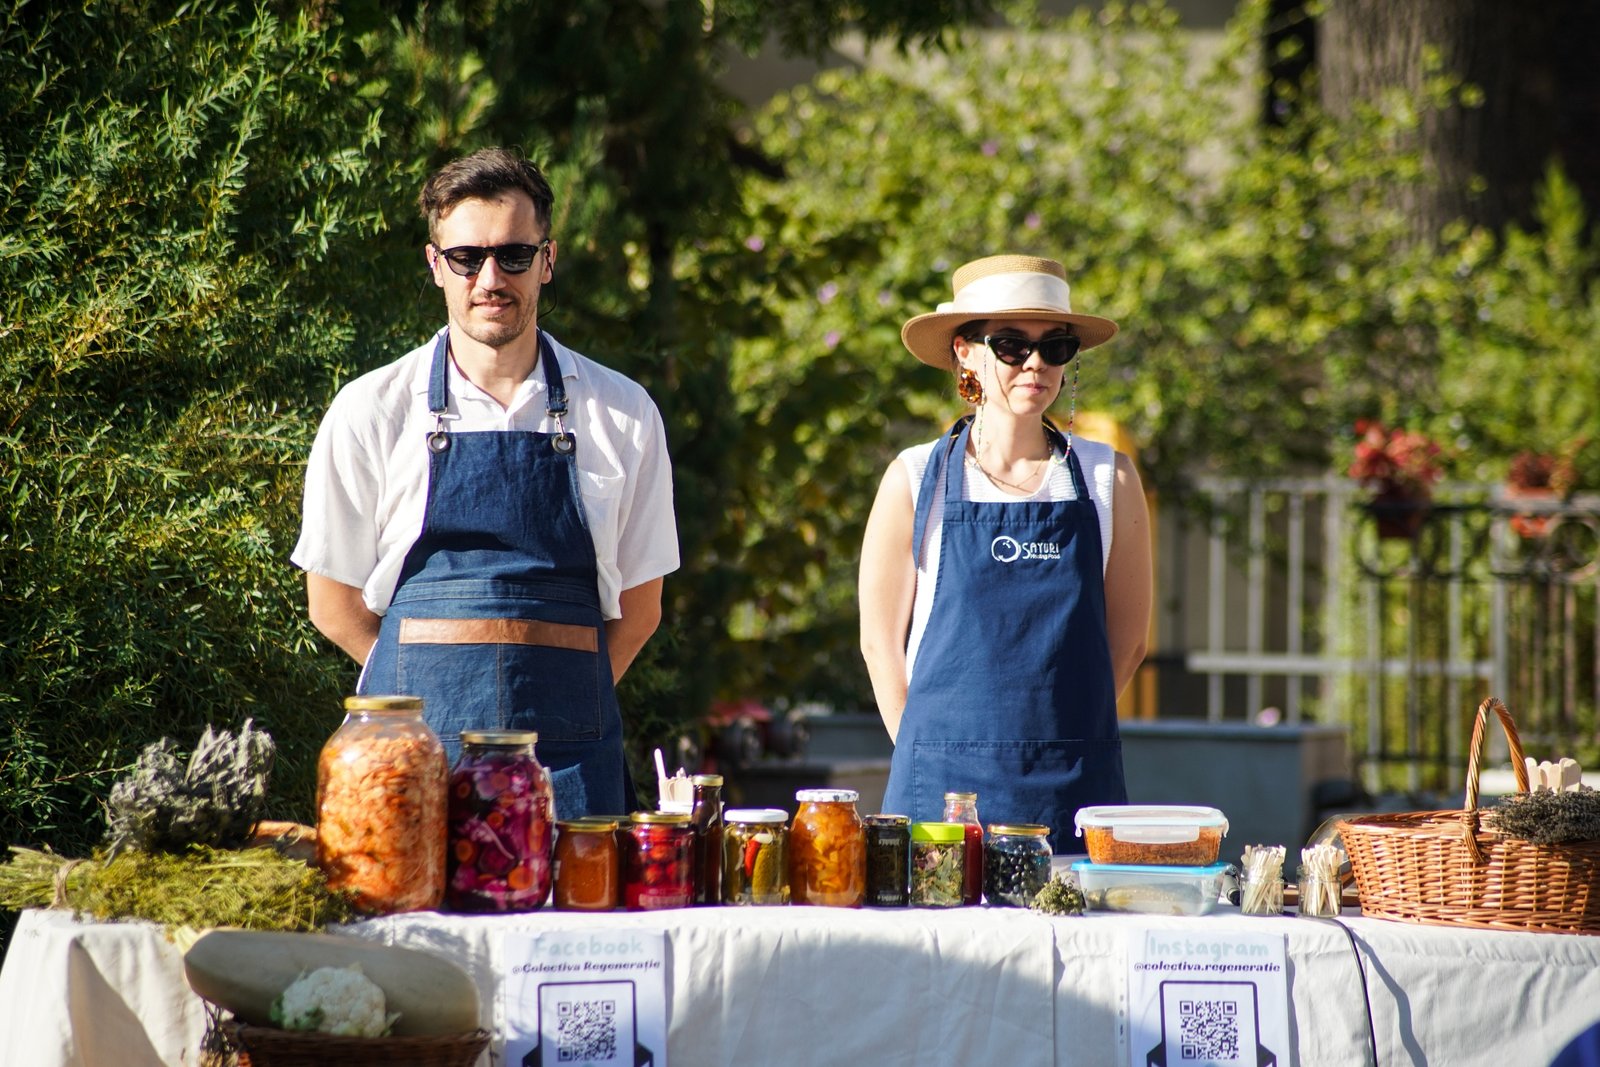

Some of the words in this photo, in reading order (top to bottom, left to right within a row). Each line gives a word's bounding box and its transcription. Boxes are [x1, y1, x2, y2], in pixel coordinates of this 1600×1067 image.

[1022, 542, 1059, 559] SAYURI
[534, 935, 643, 957] Facebook
[1150, 937, 1269, 961] Instagram
[512, 962, 580, 974] @Colectiva
[1134, 961, 1281, 973] @colectiva.regeneratie
